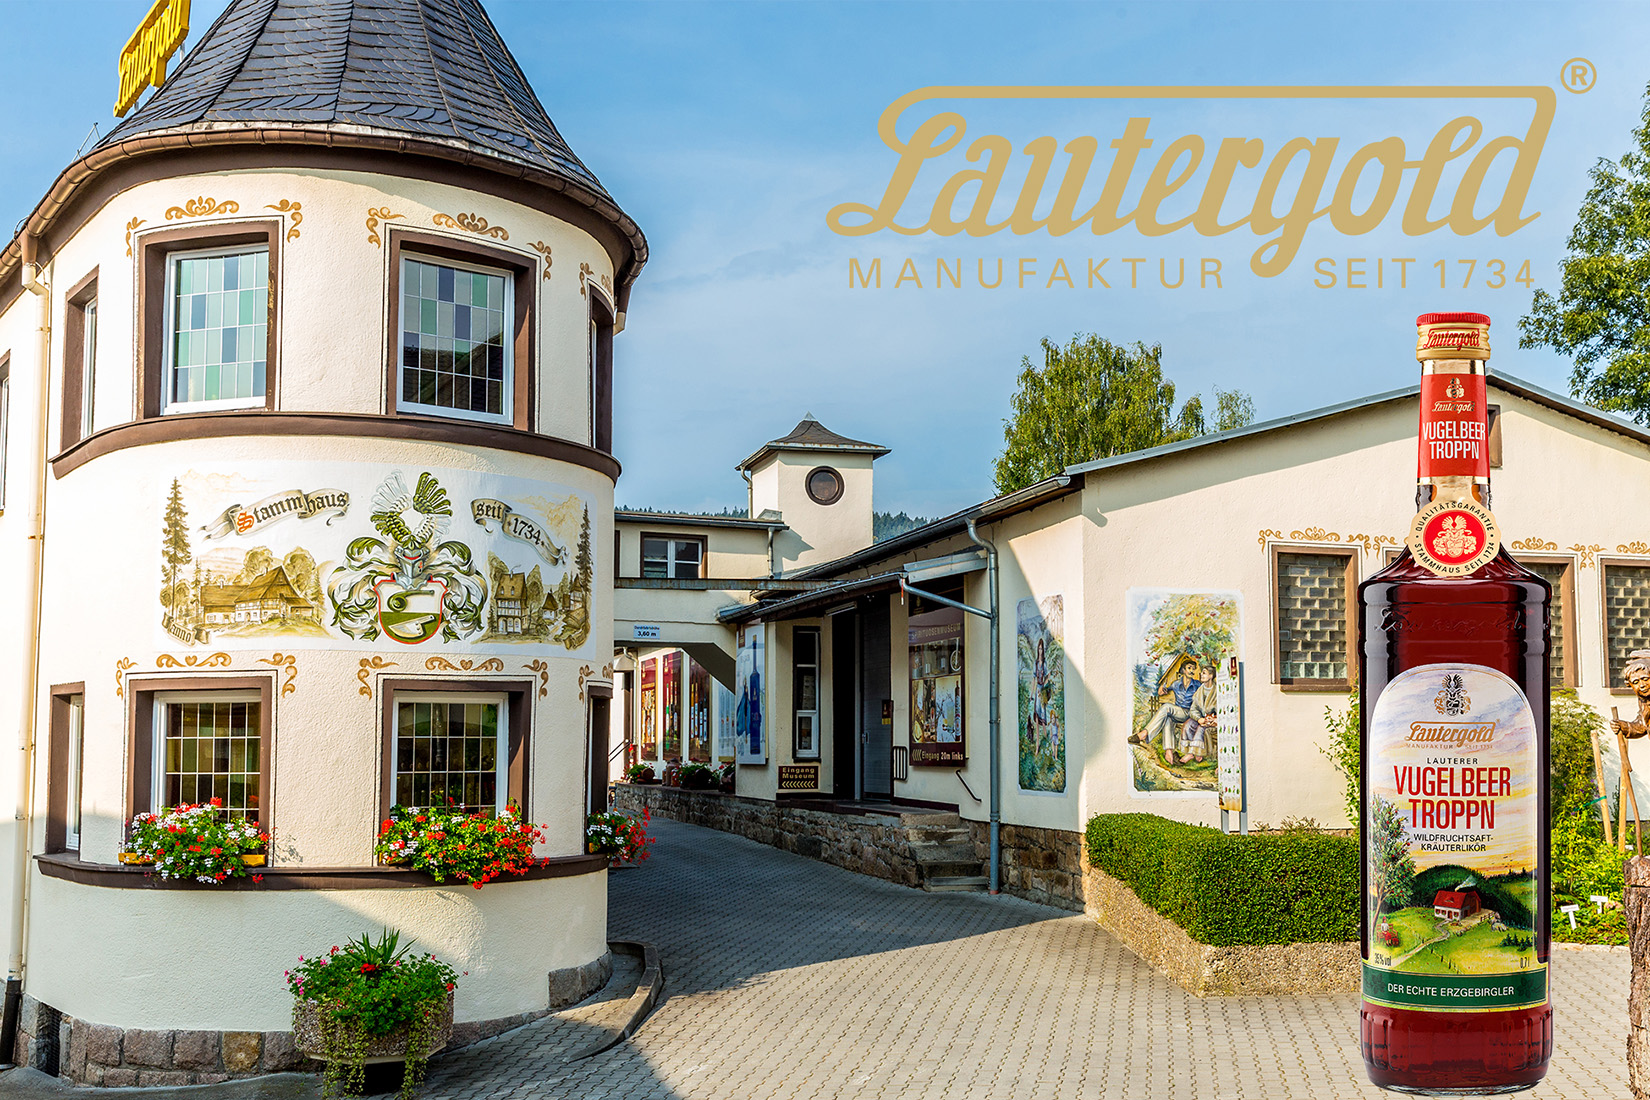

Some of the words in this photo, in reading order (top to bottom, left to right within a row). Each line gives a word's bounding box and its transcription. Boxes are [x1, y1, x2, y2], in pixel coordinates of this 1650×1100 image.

[1423, 327, 1480, 351] Lautergold
[1432, 400, 1476, 414] Lautergold
[1422, 421, 1486, 441] VUGELBEER
[1429, 440, 1480, 459] TROPPN
[236, 491, 350, 534] Stammhaus
[476, 501, 502, 519] seit
[1415, 501, 1495, 532] QUALITÄTSGARANTIE
[1414, 543, 1461, 574] STAMMHAUS
[1464, 558, 1484, 572] SEIT
[1482, 542, 1495, 559] 1734
[1404, 721, 1496, 748] Lautergold
[922, 751, 940, 761] Eingang
[1427, 757, 1478, 765] LAUTERER
[1393, 766, 1511, 797] VUGELBEER
[1408, 798, 1495, 830] TROPPN
[1413, 833, 1494, 843] WILDFRUCHTSAFT-
[1420, 842, 1486, 852] KRÄUTERLIKÖR
[1387, 982, 1404, 994] DER
[1406, 985, 1438, 997] ECHTE
[1440, 985, 1515, 997] ERZGEBIRGLER
